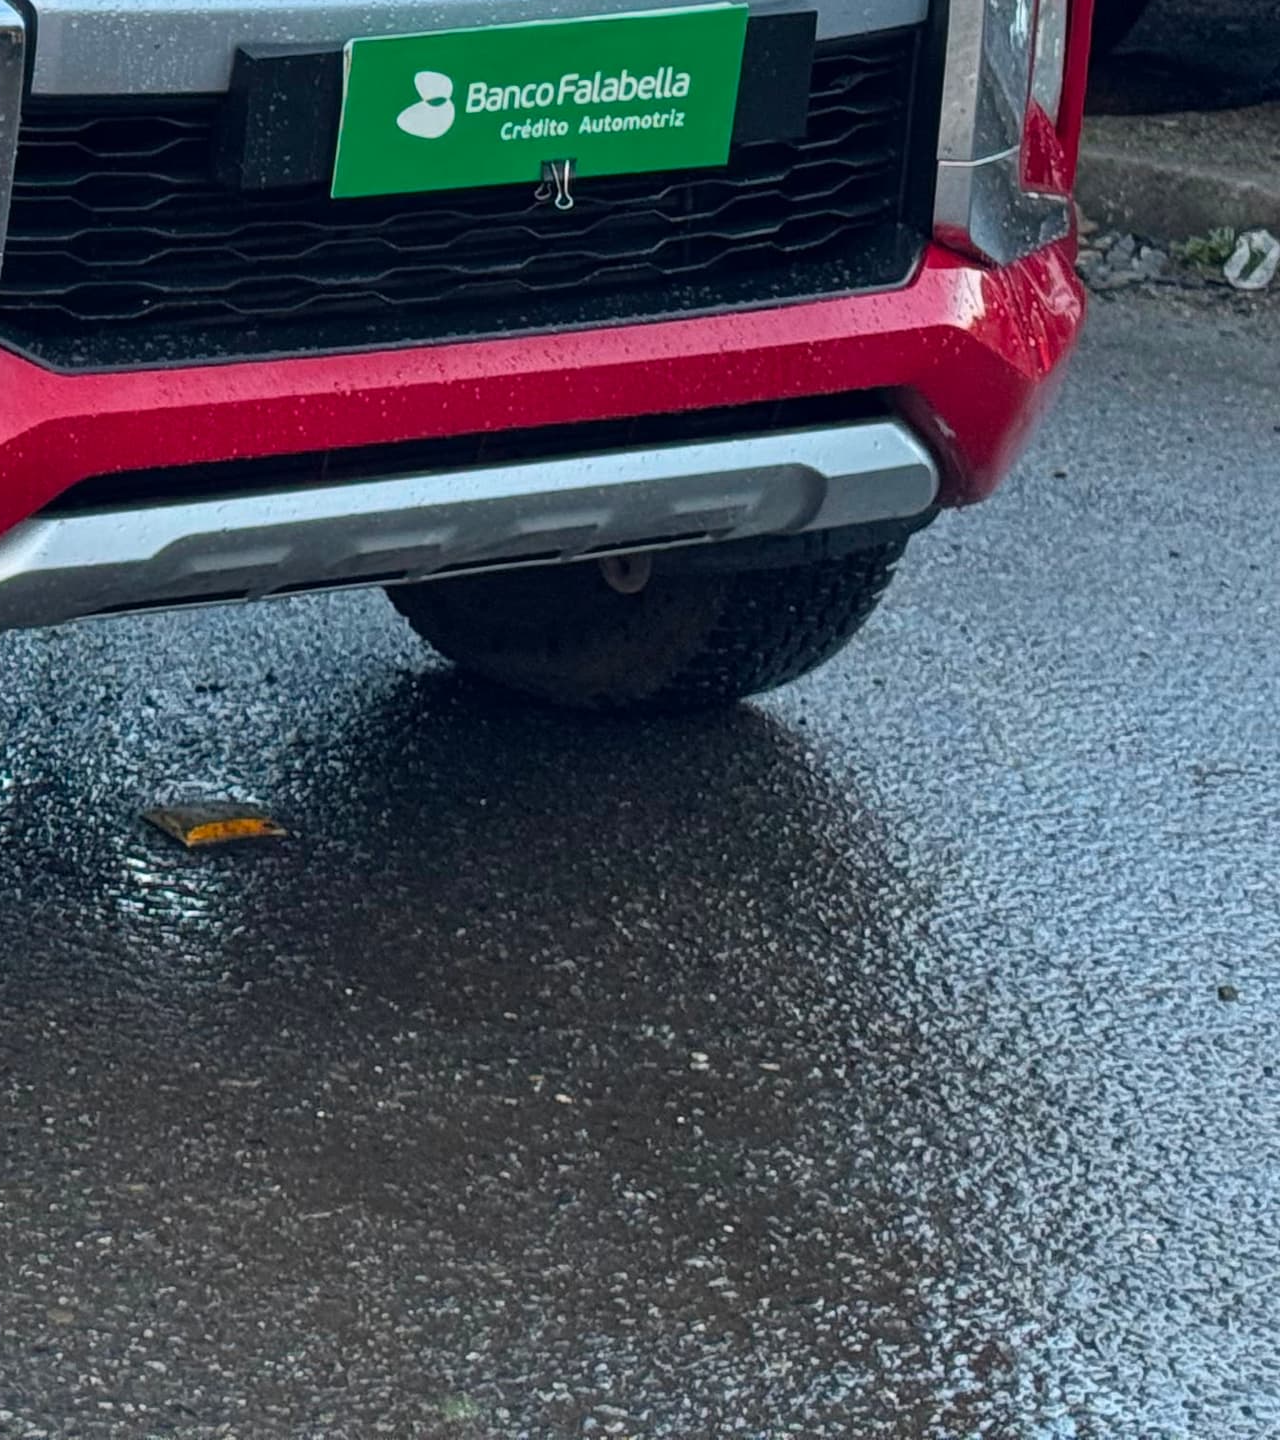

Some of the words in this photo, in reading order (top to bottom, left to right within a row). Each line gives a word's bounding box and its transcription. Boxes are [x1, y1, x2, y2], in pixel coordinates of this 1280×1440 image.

[465, 81, 554, 114] Banco
[558, 66, 691, 106] Falabella
[500, 118, 569, 141] Crédito
[579, 110, 685, 135] Automotriz
